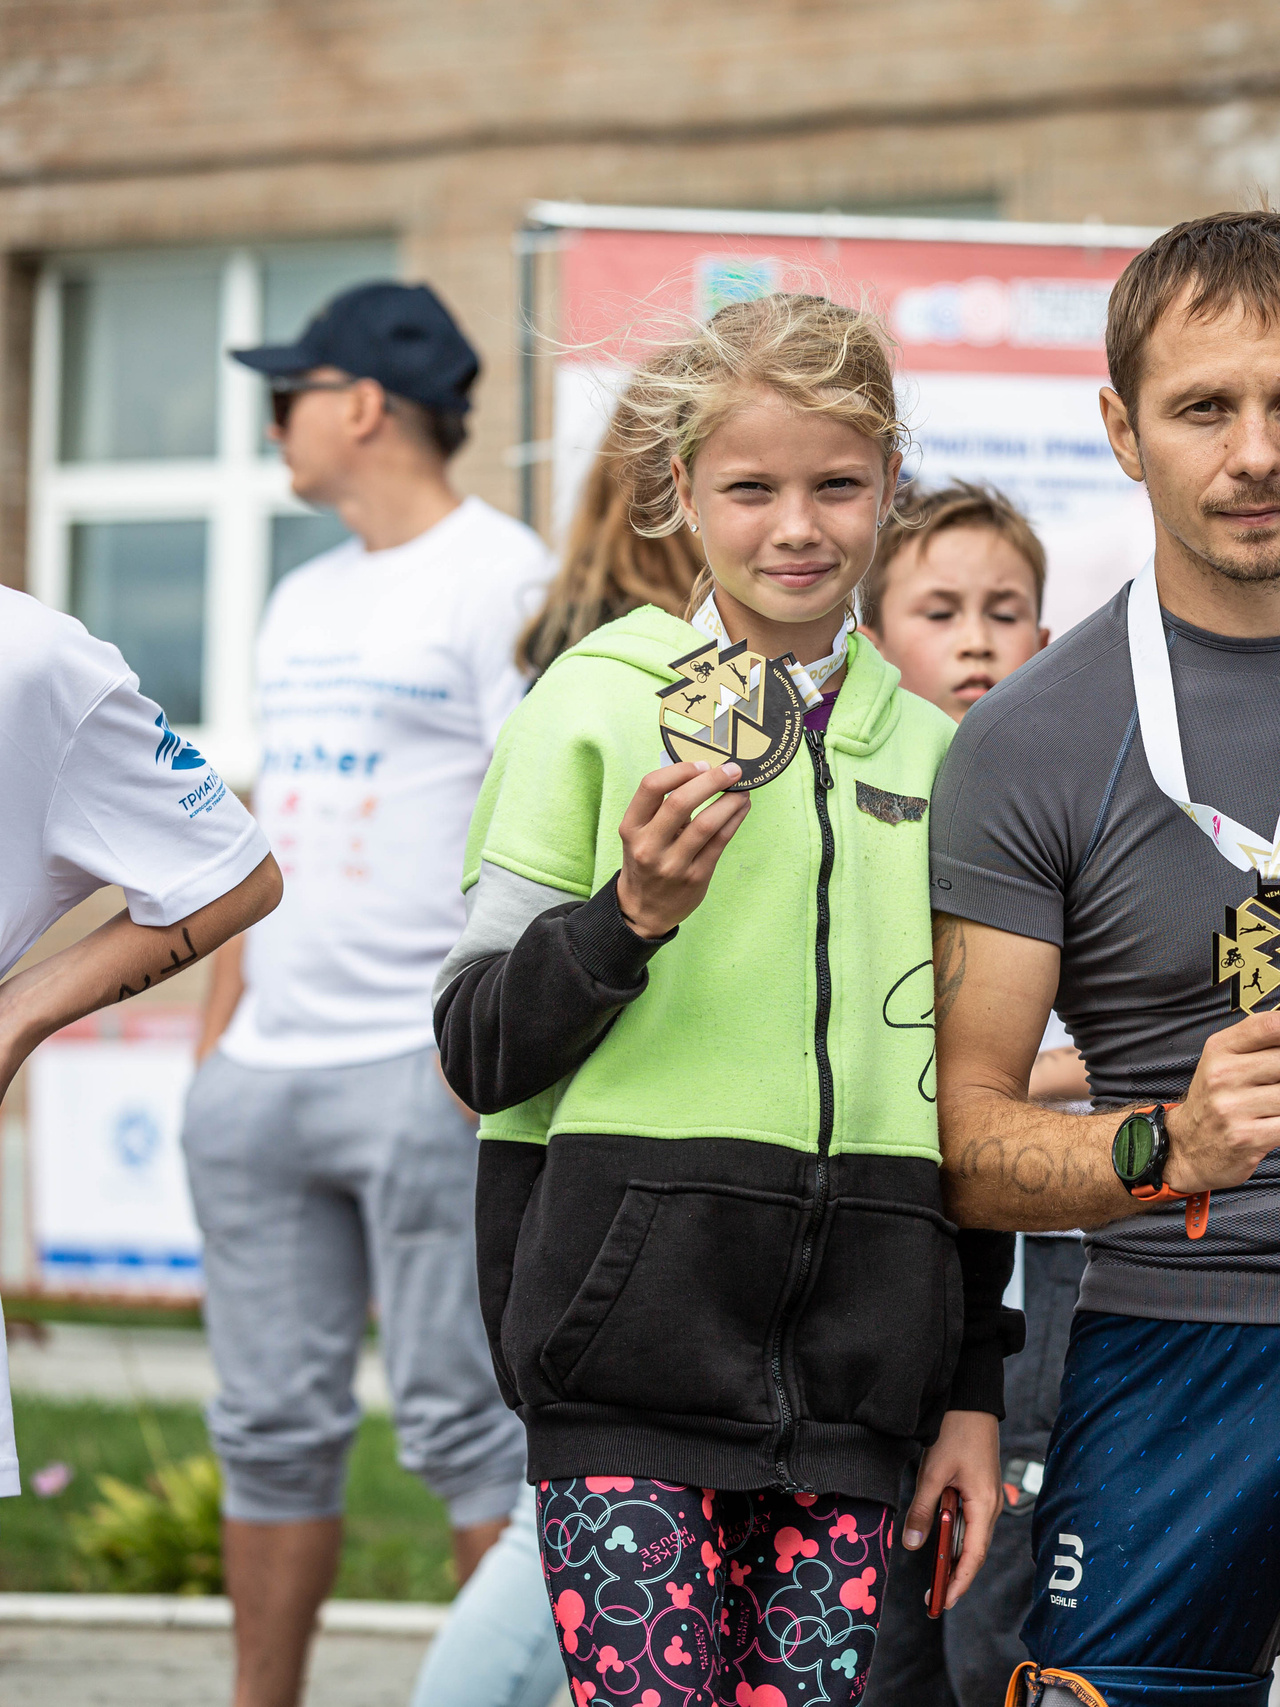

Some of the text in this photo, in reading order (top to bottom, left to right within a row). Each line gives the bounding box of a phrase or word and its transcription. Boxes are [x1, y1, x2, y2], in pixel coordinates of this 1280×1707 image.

[773, 668, 800, 708] ЧЕМПИОНАТ
[758, 718, 792, 771] ВЛАДИВОСТОК
[781, 711, 801, 764] ПРИМОРСКОГО
[753, 775, 765, 784] ПО
[764, 764, 782, 778] КРАЯ
[639, 1526, 689, 1559] MOUSE
[642, 1533, 696, 1572] MICKEY
[693, 1621, 706, 1670] MICKEY
[699, 1626, 709, 1666] MOUSE
